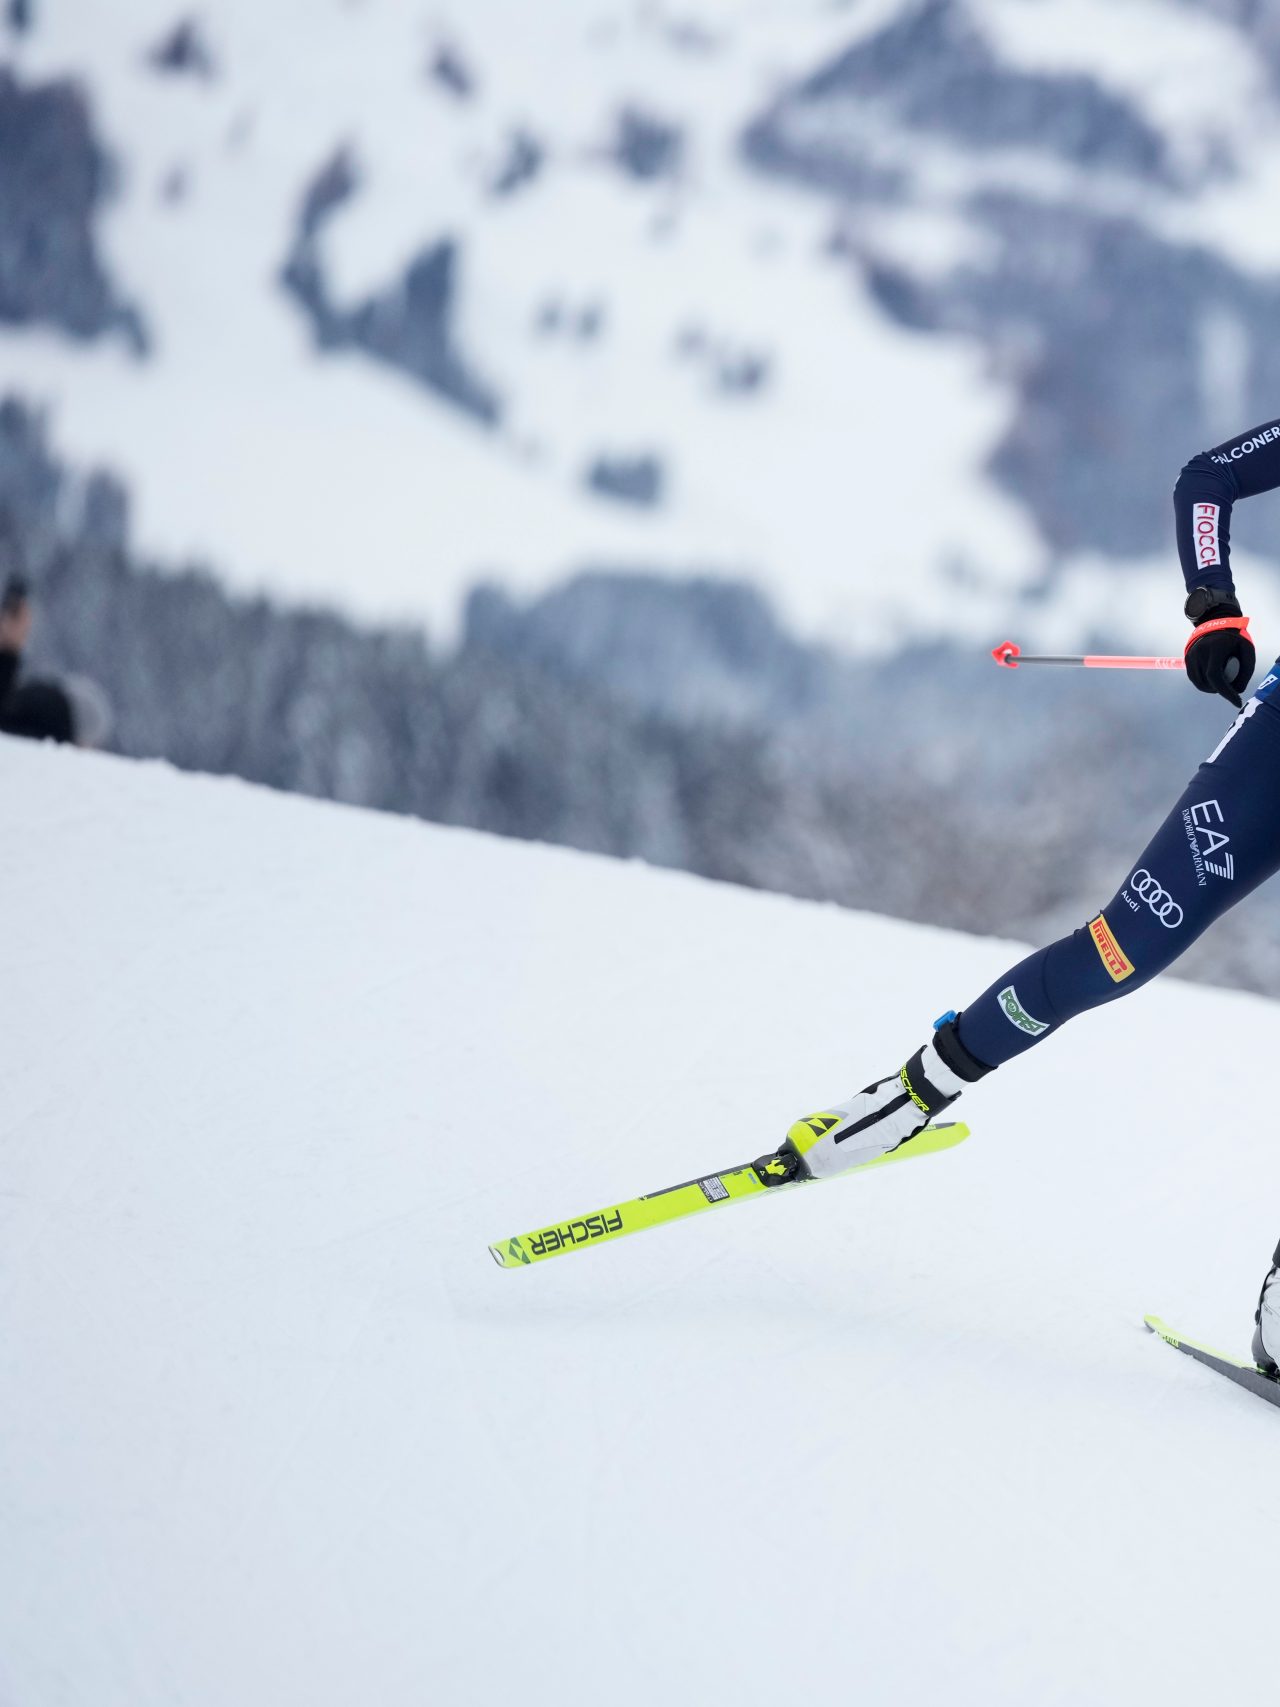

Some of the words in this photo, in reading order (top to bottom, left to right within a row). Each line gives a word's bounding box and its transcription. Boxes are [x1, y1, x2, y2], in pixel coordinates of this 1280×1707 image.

[1197, 504, 1217, 567] FIOCCH
[1181, 808, 1196, 844] EMPORIO
[1191, 848, 1207, 887] ARMANI
[1190, 799, 1234, 881] EA7
[1121, 890, 1141, 912] Audi
[1092, 919, 1128, 975] PIRELLI
[900, 1065, 930, 1111] SCHER
[527, 1209, 623, 1256] FISCHER
